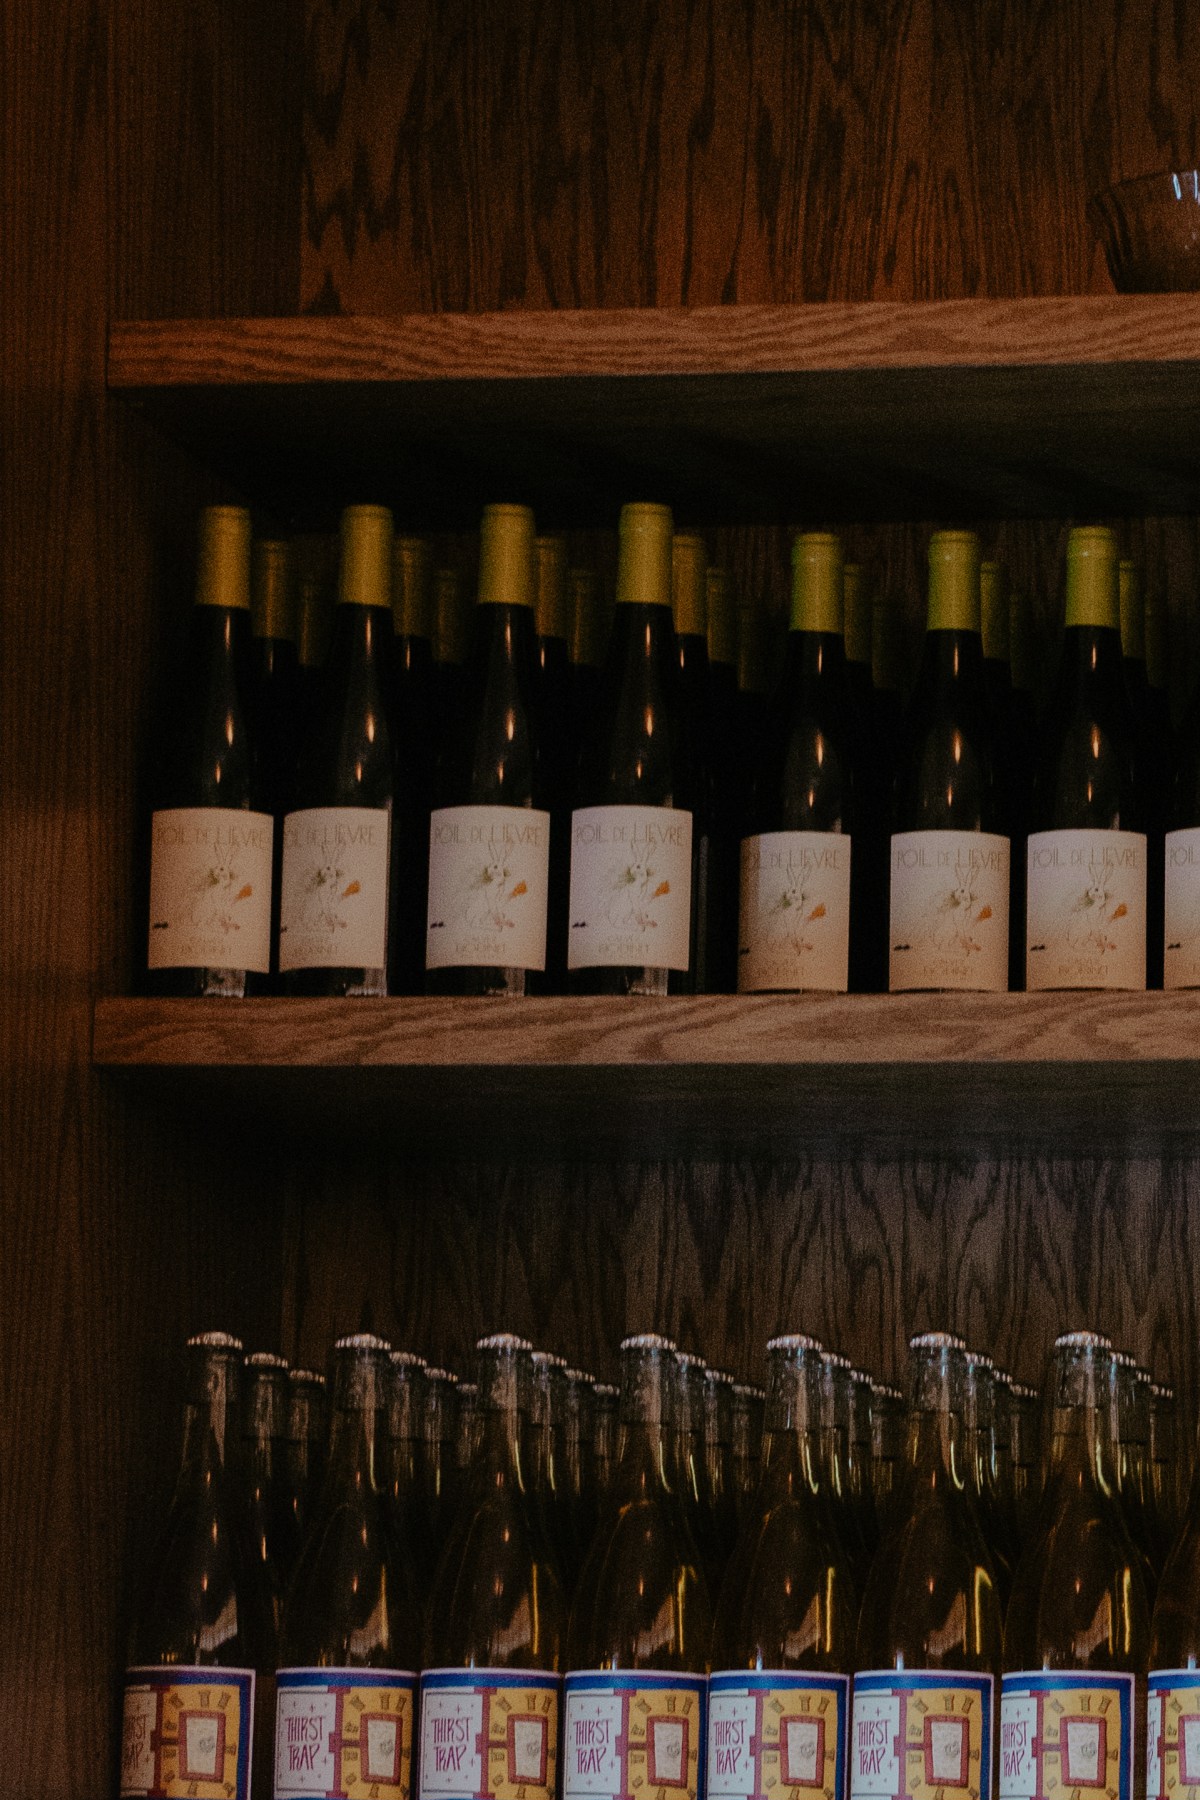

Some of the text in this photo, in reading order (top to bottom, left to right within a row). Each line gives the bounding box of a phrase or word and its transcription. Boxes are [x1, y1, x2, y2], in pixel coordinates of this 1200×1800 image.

[284, 1715, 326, 1742] THIRST
[431, 1716, 474, 1744] THIRST
[572, 1718, 613, 1746] THIRST
[713, 1719, 749, 1746] THIRST
[857, 1719, 892, 1747] THIRST
[1002, 1720, 1031, 1747] THIRST
[288, 1744, 321, 1772] TRAP
[435, 1745, 466, 1773] TRAP
[576, 1747, 606, 1774] TRAP
[715, 1747, 743, 1775] TRAP
[859, 1748, 886, 1776] TRAP
[1003, 1749, 1026, 1776] TRAP
